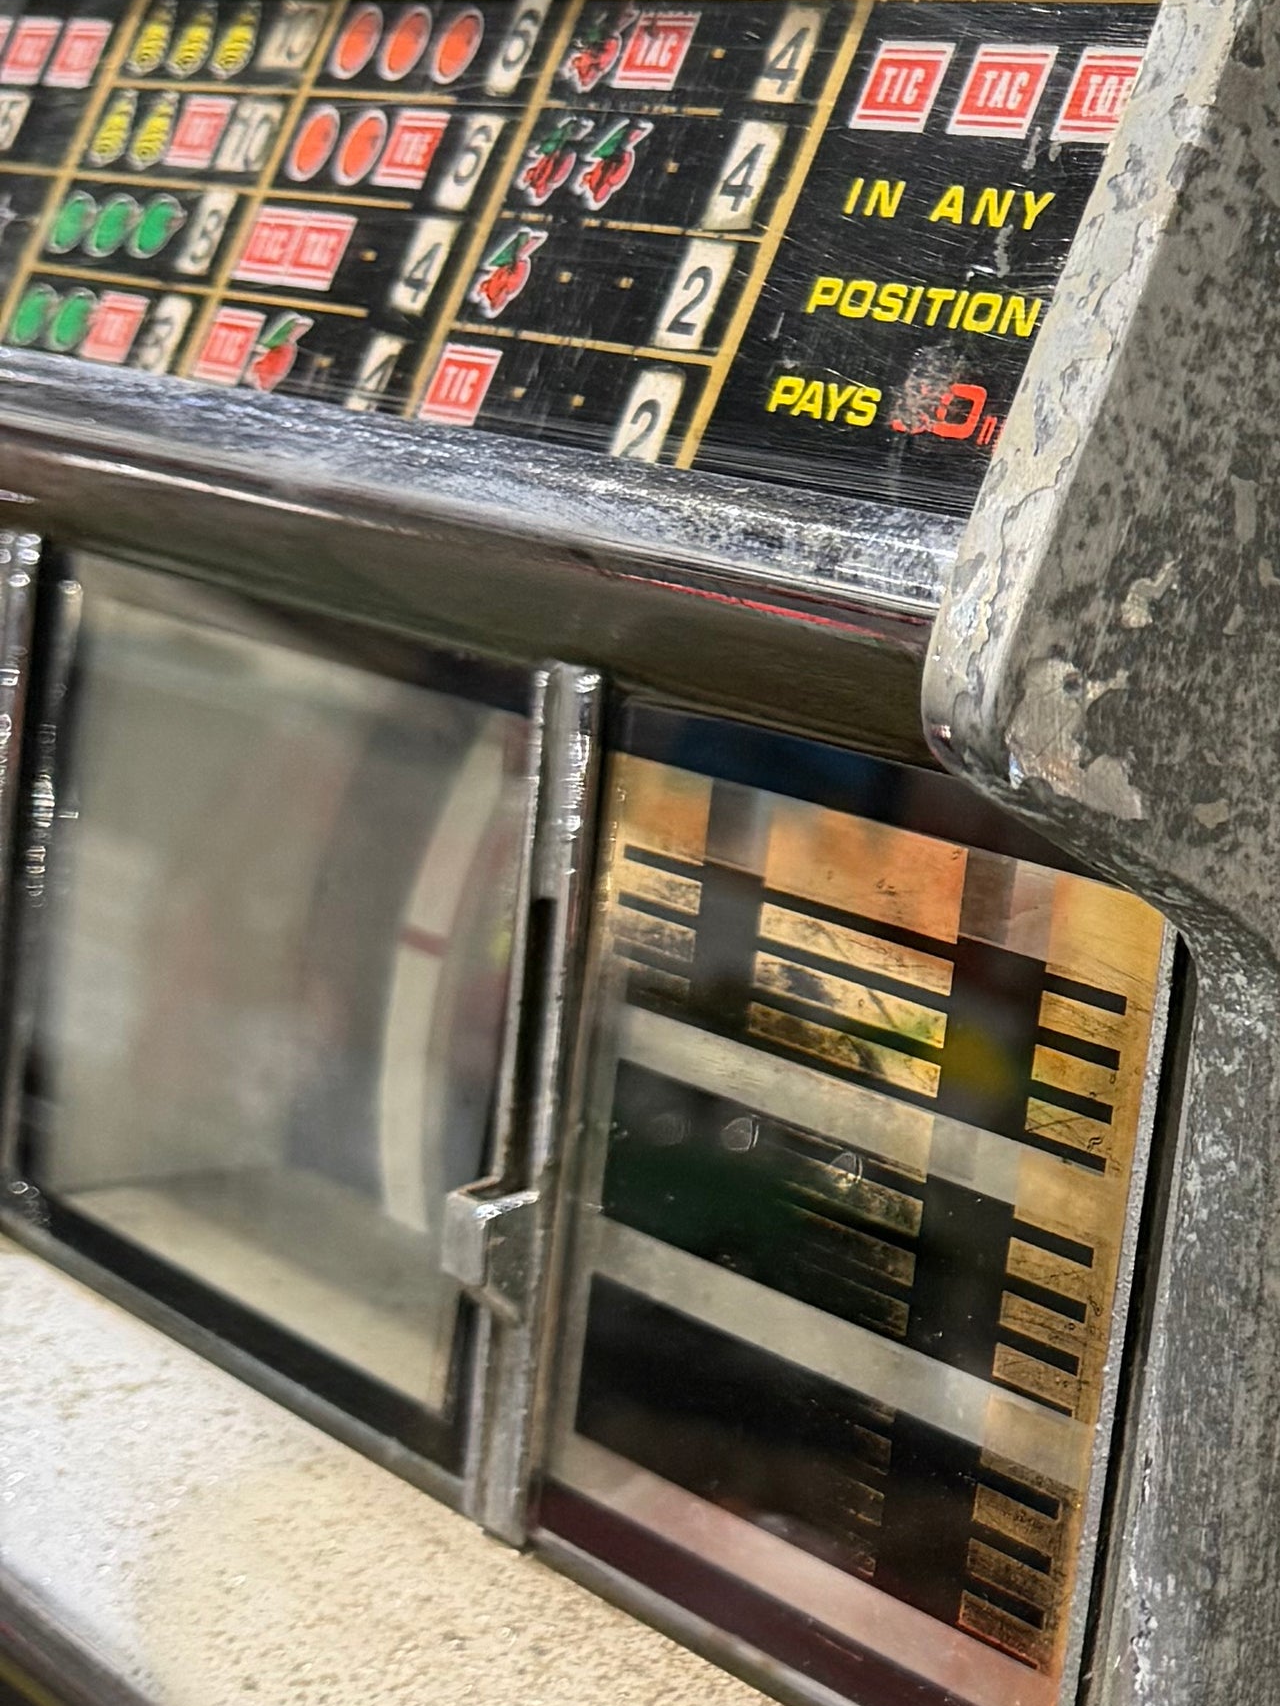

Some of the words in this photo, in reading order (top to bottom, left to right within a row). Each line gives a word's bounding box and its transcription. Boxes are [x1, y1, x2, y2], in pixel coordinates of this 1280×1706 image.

[502, 9, 541, 71] 6
[764, 28, 811, 95] 4
[875, 66, 926, 105] TIC
[976, 69, 1030, 110] TAC
[453, 125, 492, 186] 6
[718, 143, 767, 211] 4
[842, 177, 907, 218] IN
[928, 185, 1056, 231] ANY
[403, 242, 443, 303] 4
[664, 265, 713, 337] 2
[805, 276, 1043, 337] POSITION
[439, 364, 480, 404] TIC
[766, 375, 882, 426] PAYS
[619, 398, 662, 457] 2
